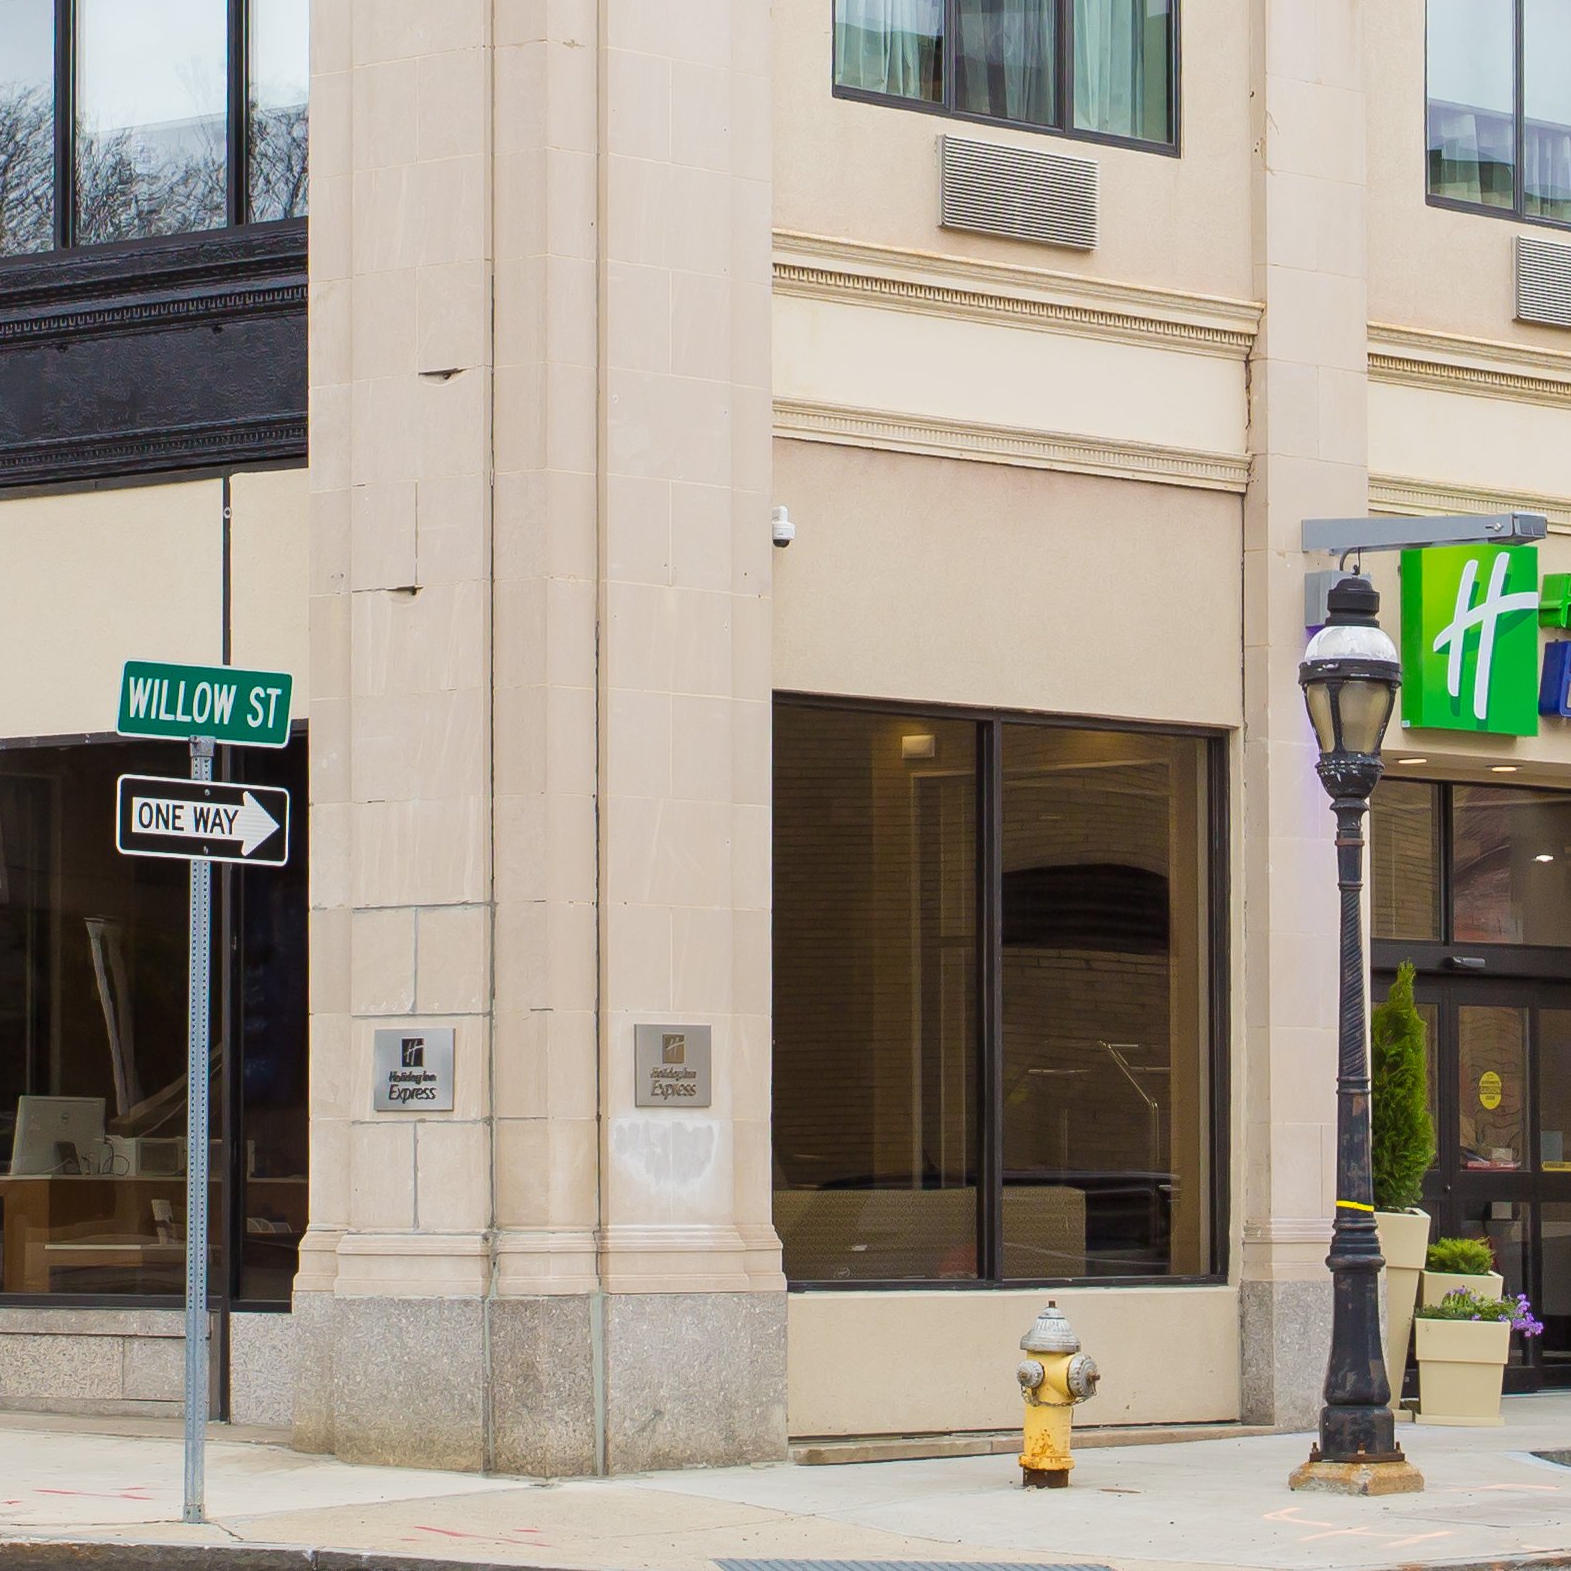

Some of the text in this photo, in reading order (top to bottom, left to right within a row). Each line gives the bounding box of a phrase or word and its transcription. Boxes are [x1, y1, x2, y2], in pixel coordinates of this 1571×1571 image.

[129, 677, 282, 729] WILLOW ST
[138, 801, 239, 836] ONE WAY
[388, 1084, 436, 1104] Express
[651, 1080, 696, 1100] Express
